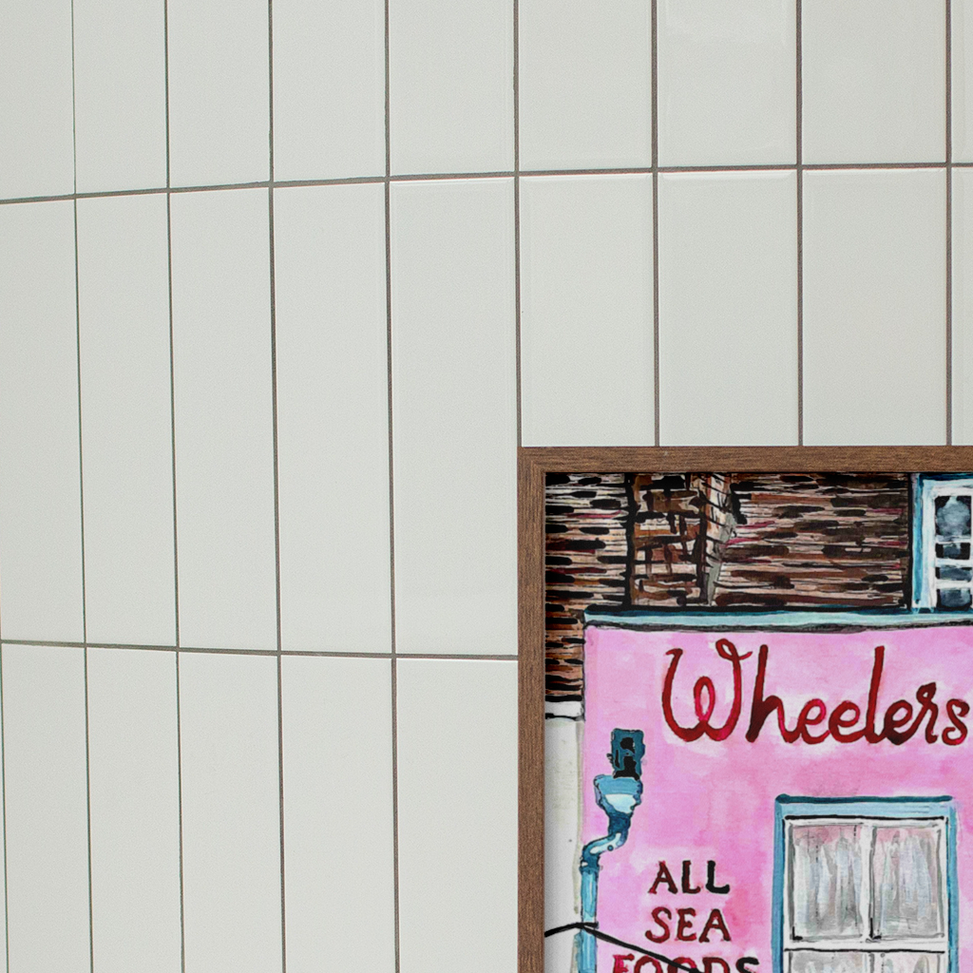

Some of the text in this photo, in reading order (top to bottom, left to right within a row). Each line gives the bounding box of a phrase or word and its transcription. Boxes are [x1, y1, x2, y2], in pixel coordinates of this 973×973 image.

[661, 638, 971, 745] Wheelers
[647, 860, 730, 894] ALL
[645, 906, 732, 943] SEA
